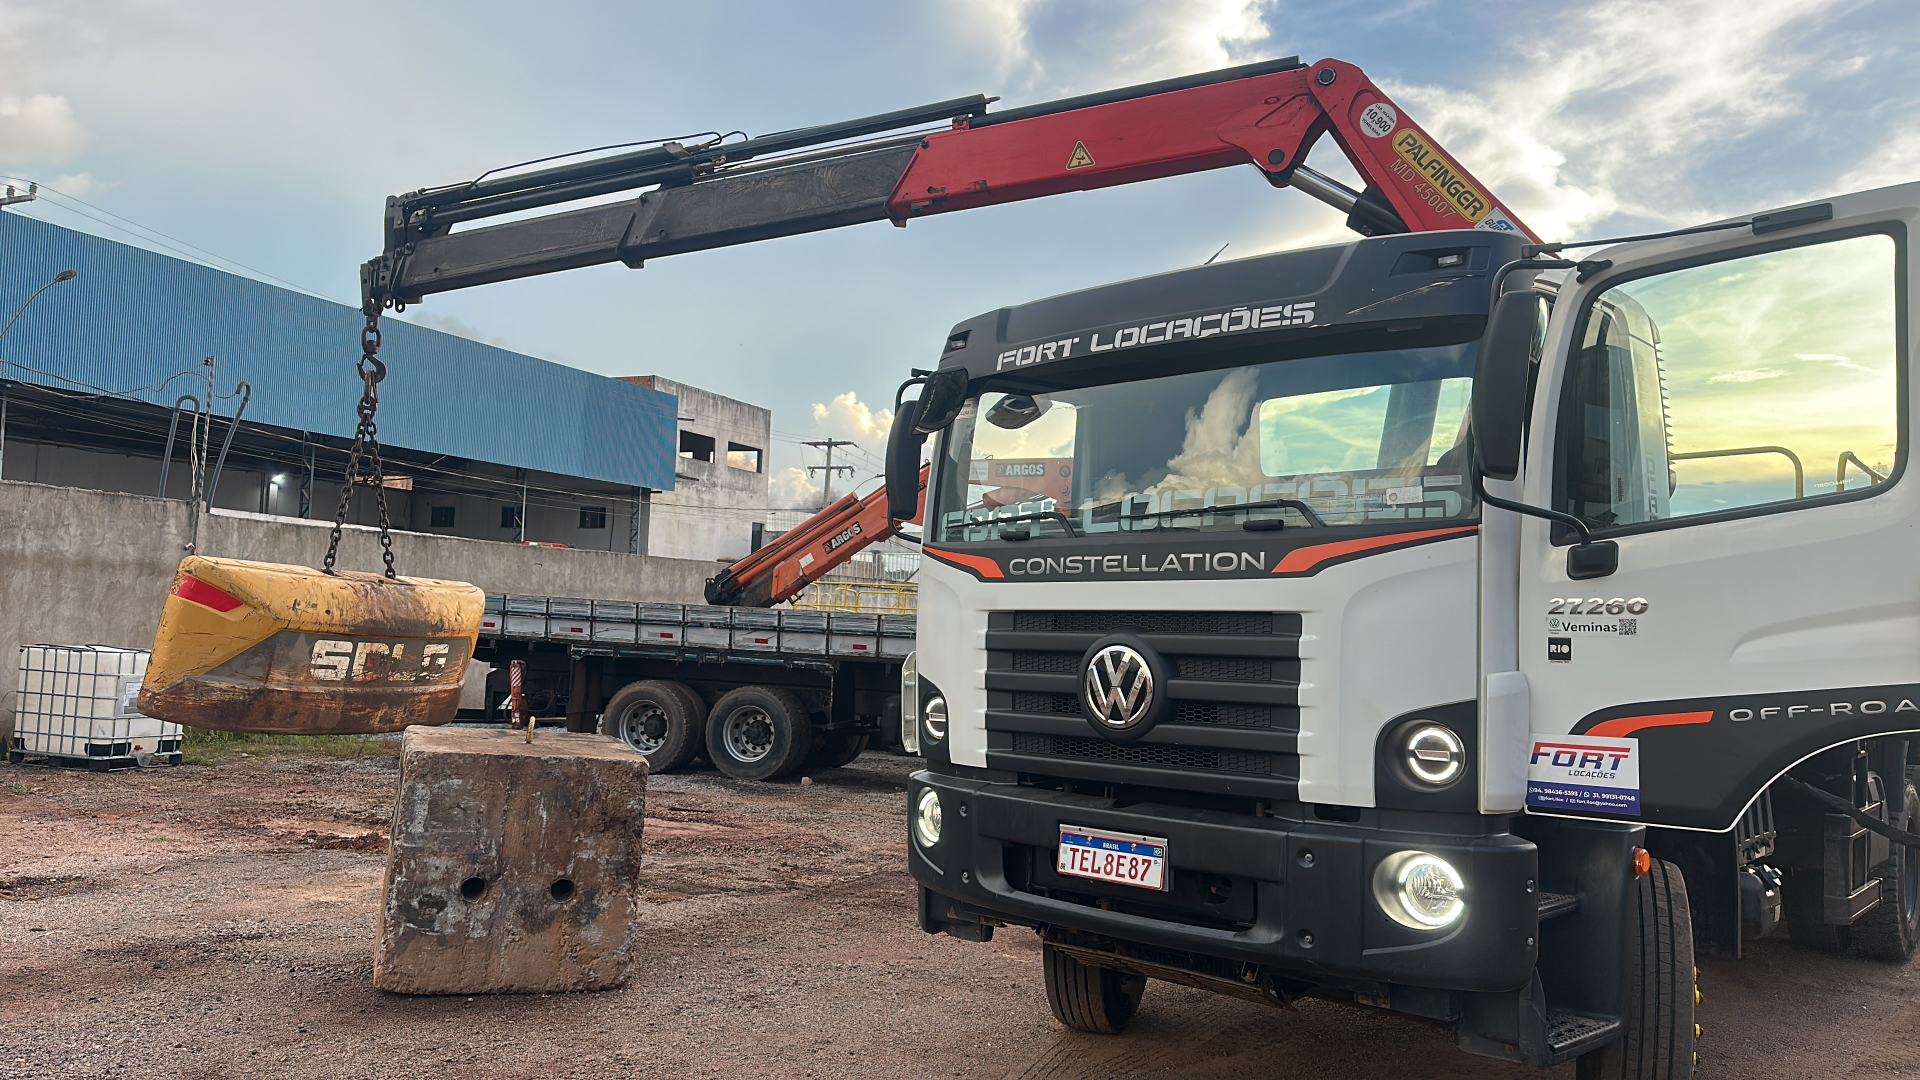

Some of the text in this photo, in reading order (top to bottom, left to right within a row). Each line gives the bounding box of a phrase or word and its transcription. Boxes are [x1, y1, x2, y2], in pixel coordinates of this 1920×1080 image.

[1366, 108, 1391, 132] 10,900
[1397, 133, 1484, 217] PALFINGER
[1389, 158, 1457, 219] MD 45007
[996, 302, 1315, 371] FORT LOCAÇÕES
[1005, 464, 1044, 476] ARGOS
[1009, 551, 1265, 575] CONSTELLATION
[1562, 622, 1618, 632] Veminas
[1550, 644, 1570, 654] RIO
[1729, 699, 1920, 722] OFF-ROA
[1530, 742, 1631, 770] FORT
[1568, 770, 1616, 779] LOCAÇÕES
[1102, 842, 1119, 850] BRASIL
[1070, 848, 1151, 881] TEL8E87
